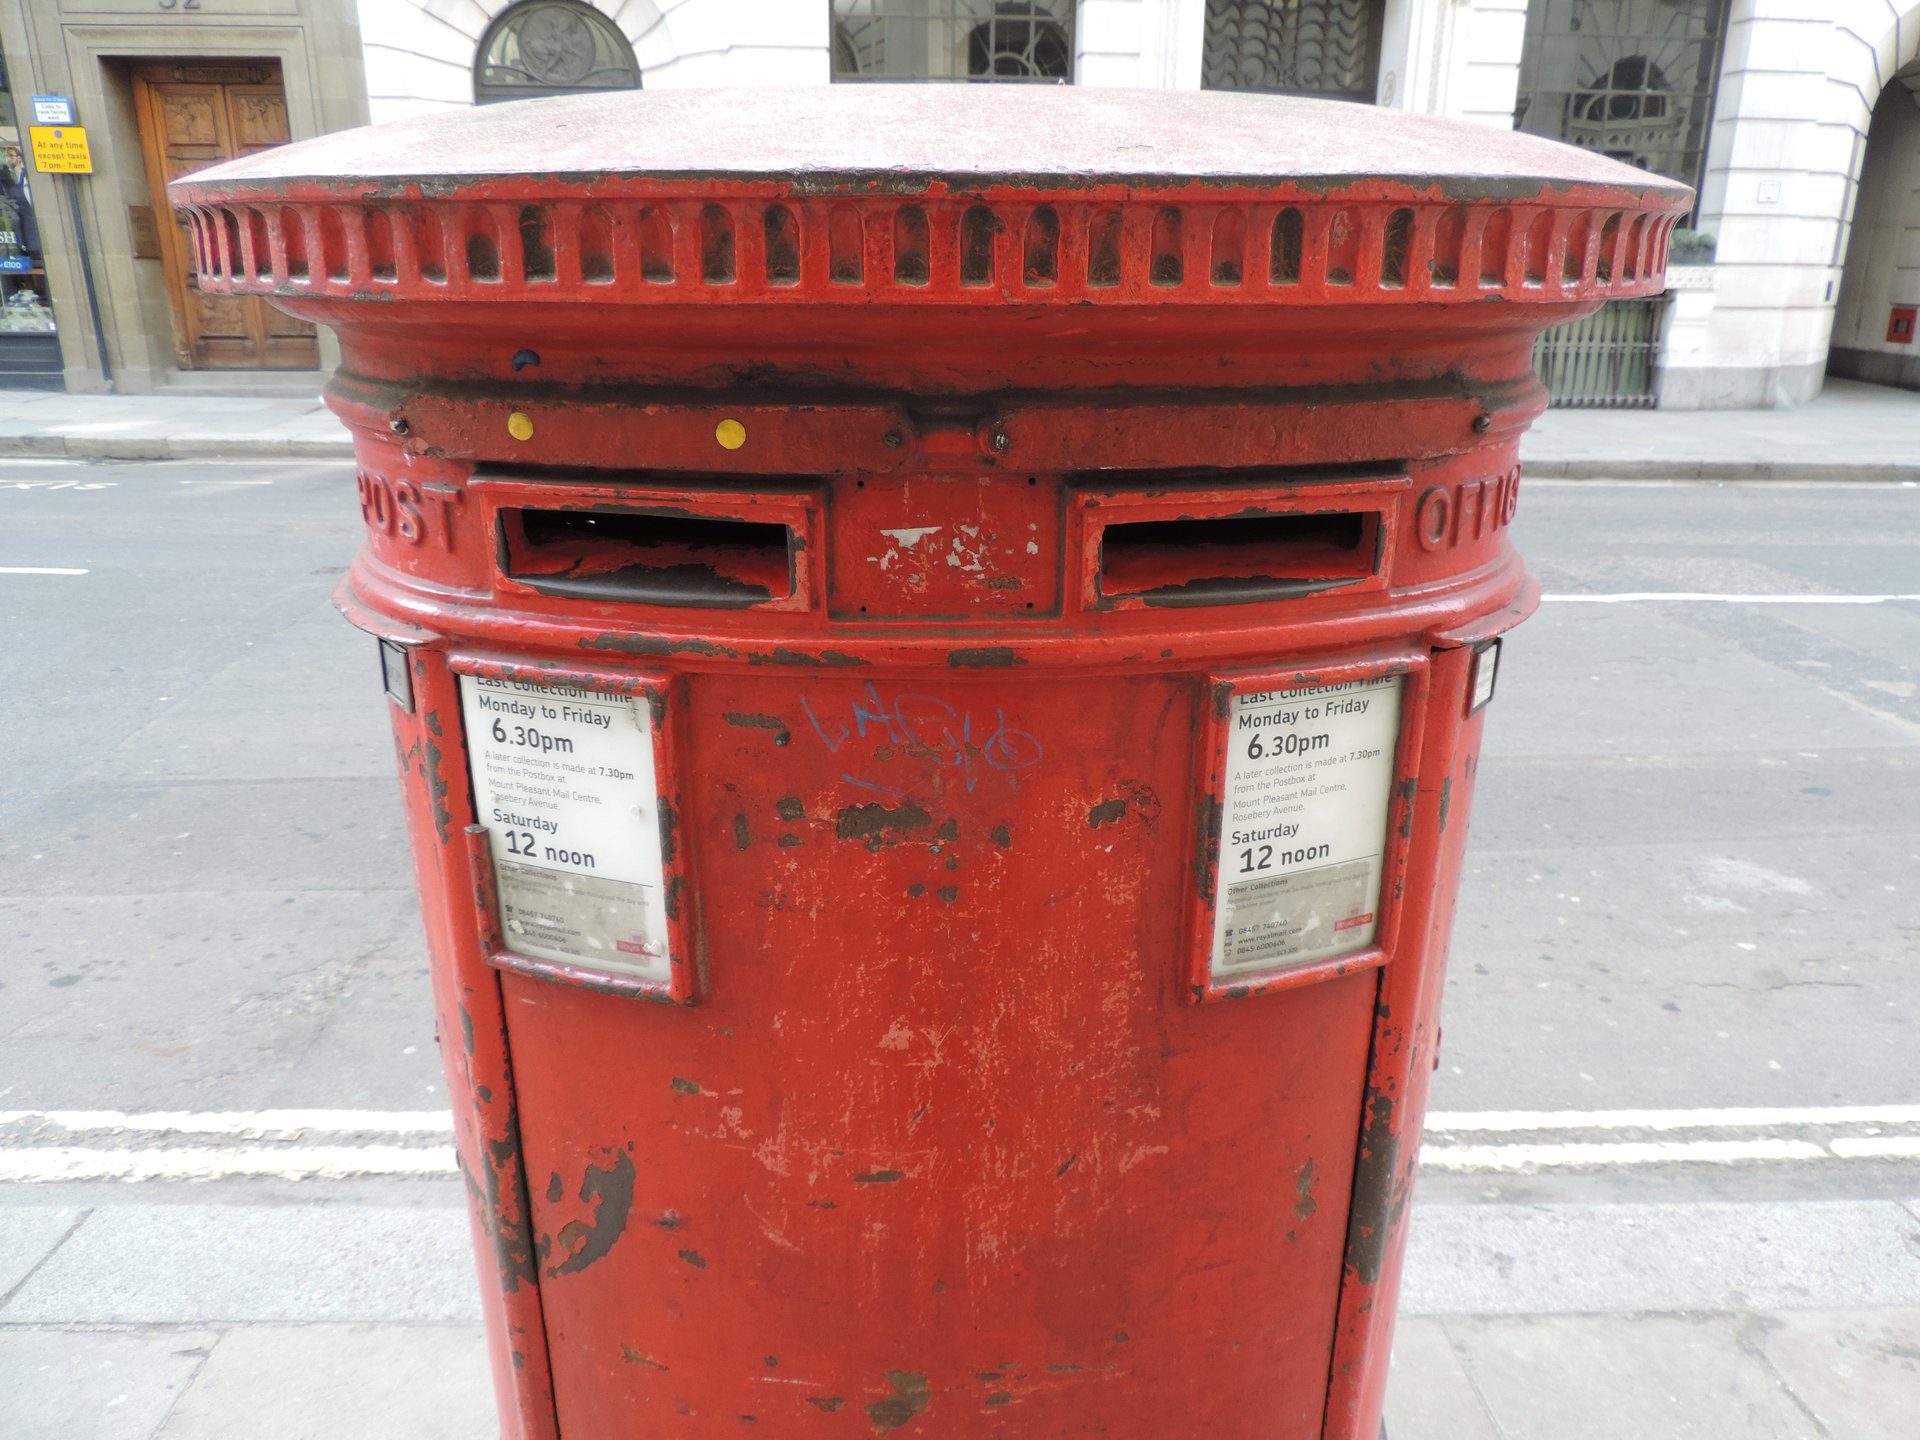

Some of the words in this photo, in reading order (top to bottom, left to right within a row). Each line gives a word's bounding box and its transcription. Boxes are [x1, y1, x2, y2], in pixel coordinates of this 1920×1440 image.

[357, 470, 463, 554] POST
[478, 694, 536, 718] Monday
[541, 704, 556, 720] to
[563, 706, 611, 729] Friday
[1239, 710, 1300, 730] Monday
[1305, 707, 1319, 720] to
[1325, 699, 1370, 717] Friday
[492, 718, 574, 753] 6.30pm
[1248, 733, 1330, 760] 6.30pm
[485, 750, 491, 759] A
[493, 752, 510, 762] later
[513, 755, 550, 768] collection
[553, 760, 560, 769] is
[562, 762, 586, 774] made
[588, 767, 596, 775] at
[598, 766, 634, 780] 7.30pm
[486, 763, 506, 773] from
[508, 766, 521, 776] the
[523, 769, 555, 782] Postbox
[557, 774, 566, 783] at
[1234, 772, 1241, 781] A
[1244, 769, 1263, 780] later
[1265, 762, 1303, 776] collection
[1305, 760, 1312, 769] is
[1314, 756, 1337, 768] made
[1339, 755, 1347, 764] at
[1350, 749, 1380, 761] 7.30pm
[488, 778, 514, 791] Mount
[516, 782, 551, 796] Pleasant
[553, 788, 570, 799] Mail
[1234, 784, 1254, 794] from
[1257, 780, 1271, 790] the
[1273, 775, 1306, 787] Postbox
[1308, 773, 1316, 782] at
[1233, 797, 1260, 809] Mount
[1262, 792, 1298, 805] Pleasant
[1300, 788, 1317, 798] Mail
[493, 808, 558, 834] Saturday
[1232, 807, 1271, 823] Rosebery
[1232, 823, 1300, 846] Saturday
[505, 830, 537, 857] 12
[545, 846, 595, 868] noon
[1240, 844, 1273, 873] 12
[1281, 843, 1330, 866] noon
[1228, 886, 1248, 895] Other
[1250, 879, 1288, 891] Collections
